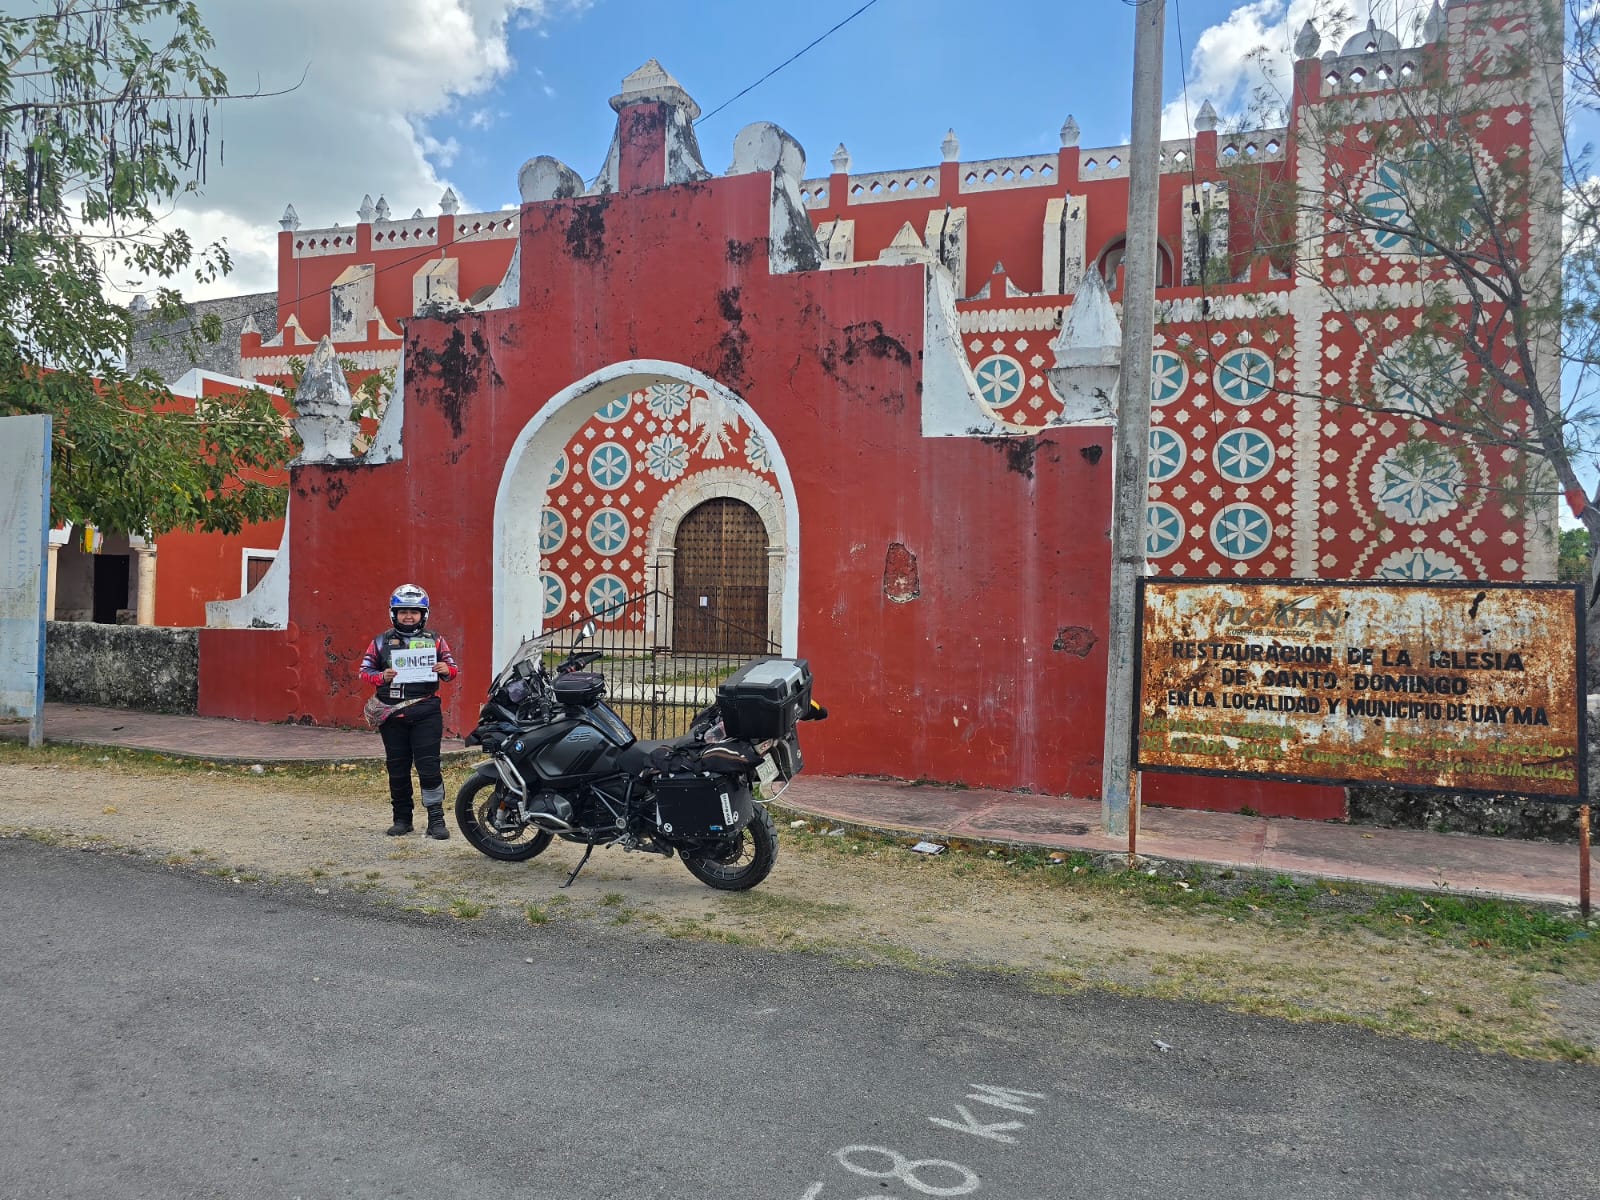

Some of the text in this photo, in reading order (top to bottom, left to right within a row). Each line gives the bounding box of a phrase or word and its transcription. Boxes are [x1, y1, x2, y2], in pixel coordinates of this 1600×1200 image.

[1347, 647, 1373, 666] DE
[1382, 649, 1411, 667] LA
[1430, 650, 1525, 671] IGLESIA
[1222, 668, 1248, 686] DE
[1354, 673, 1468, 695] DOMINGO
[1168, 690, 1190, 706] EN
[1193, 691, 1217, 708] LA
[1222, 692, 1321, 714] LOCALIDAD
[1326, 697, 1340, 715] Y
[1347, 699, 1442, 721] MUNICIPIO
[1446, 704, 1468, 721] DE
[1170, 737, 1229, 757] ESTADO
[928, 1082, 1047, 1145] KM
